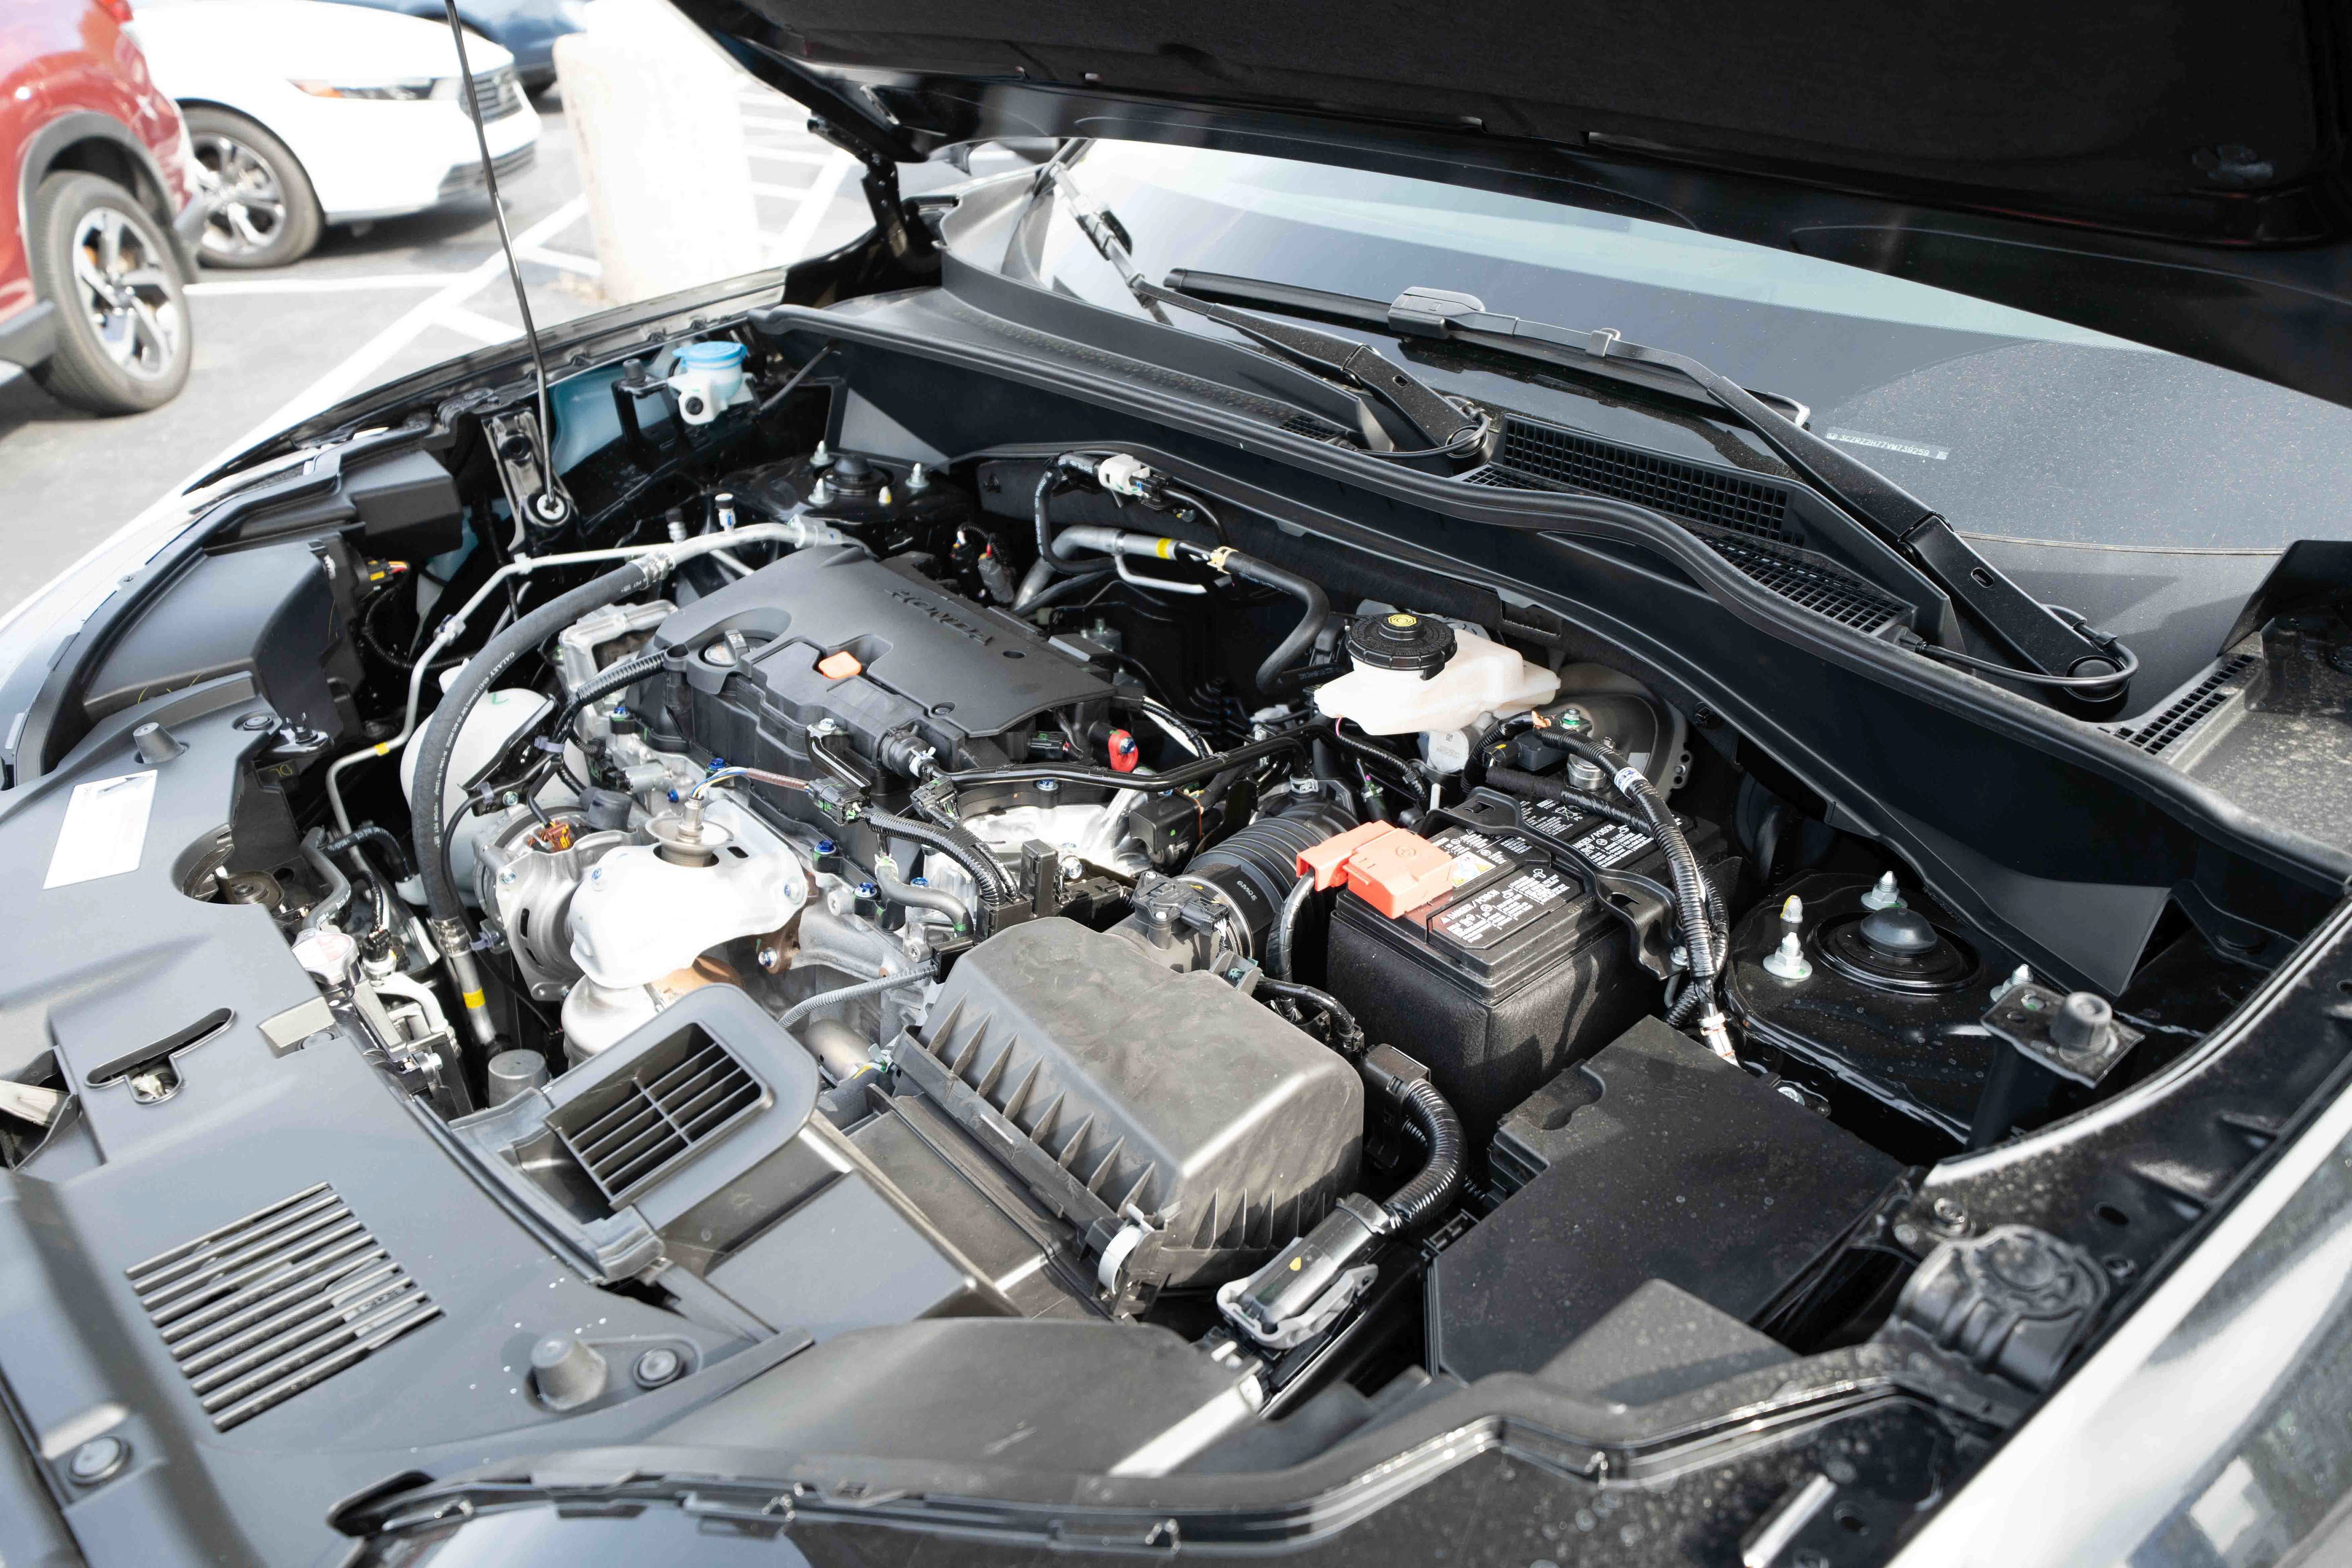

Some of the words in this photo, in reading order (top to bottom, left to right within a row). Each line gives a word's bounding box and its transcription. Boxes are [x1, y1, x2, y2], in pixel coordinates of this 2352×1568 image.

[490, 652, 515, 678] GALAXY
[445, 732, 454, 748] HOSE
[1593, 824, 1616, 837] POISON
